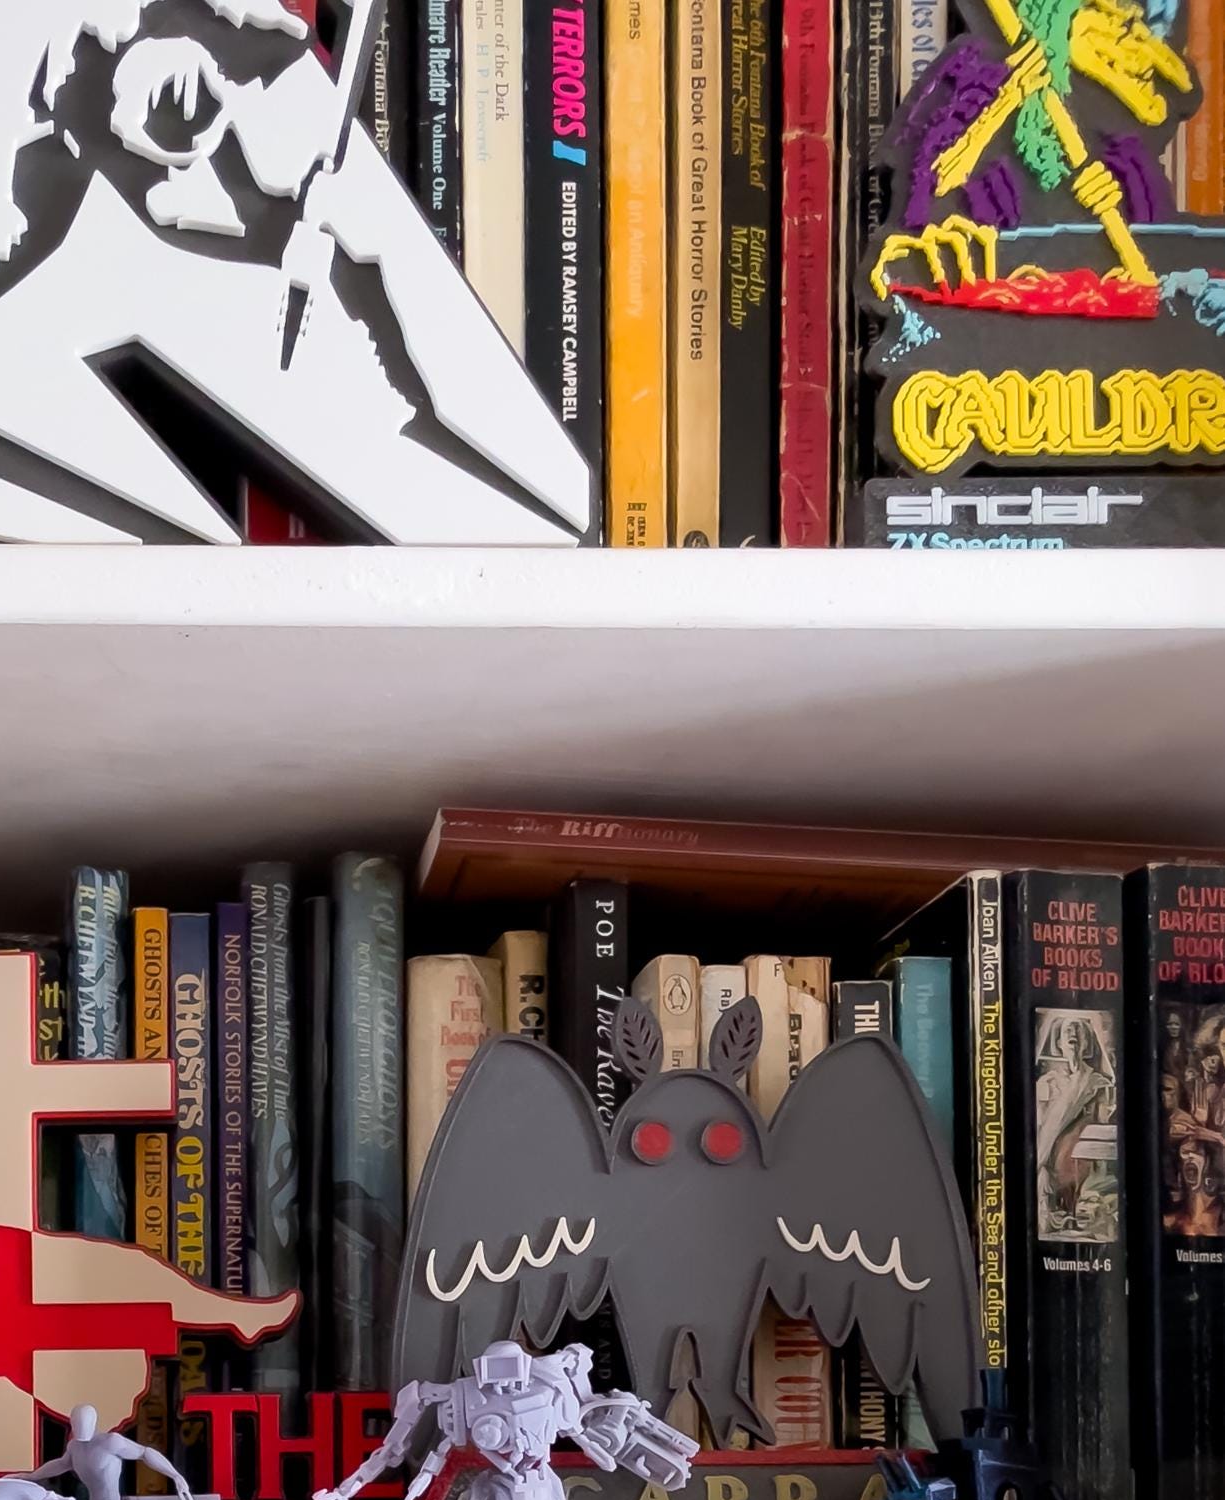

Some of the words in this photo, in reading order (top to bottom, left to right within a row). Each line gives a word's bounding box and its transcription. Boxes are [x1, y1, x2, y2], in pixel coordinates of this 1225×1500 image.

[690, 0, 706, 69] ontana
[428, 48, 452, 106] Reader
[552, 7, 587, 138] TERRORS
[691, 76, 707, 126] Book
[432, 112, 447, 174] Volume
[691, 131, 707, 153] of
[432, 178, 447, 211] One
[562, 181, 578, 238] EDITED
[691, 157, 708, 213] Great
[562, 242, 578, 264] BY
[691, 219, 708, 284] Horror
[729, 226, 749, 275] Mary
[749, 225, 767, 277] Edited
[562, 266, 579, 334] RAMSEY
[728, 277, 747, 331] Danby
[746, 278, 763, 306] by
[690, 288, 708, 361] Stories
[562, 338, 579, 422] CAMPBELL
[886, 486, 1144, 525] sinclair
[595, 900, 615, 958] POE
[981, 899, 995, 941] Joan
[1032, 922, 1119, 945] BARKER'S
[1047, 900, 1097, 922] CLIVE
[224, 933, 242, 1024] NORFOLK
[981, 943, 996, 992] Aiken
[1031, 968, 1051, 987] OF
[1058, 970, 1119, 991] BLOOD
[1044, 947, 1103, 967] BOOKS
[982, 1002, 1000, 1034] The
[175, 972, 207, 1130] GHOSTS
[224, 1031, 243, 1104] STORIES
[981, 1038, 1000, 1118] Kingdom
[224, 1111, 243, 1137] OF
[984, 1121, 1001, 1177] Under
[176, 1135, 205, 1190] OF
[224, 1142, 243, 1177] THE
[985, 1180, 1001, 1208] the
[176, 1193, 206, 1276] THE
[224, 1182, 245, 1296] SUPERNATU
[986, 1212, 1002, 1246] Sea
[986, 1251, 1002, 1284] and
[1043, 1257, 1090, 1272] Volumes
[1092, 1258, 1112, 1272] 4-6
[987, 1287, 1002, 1332] other
[183, 1393, 405, 1500] THE
